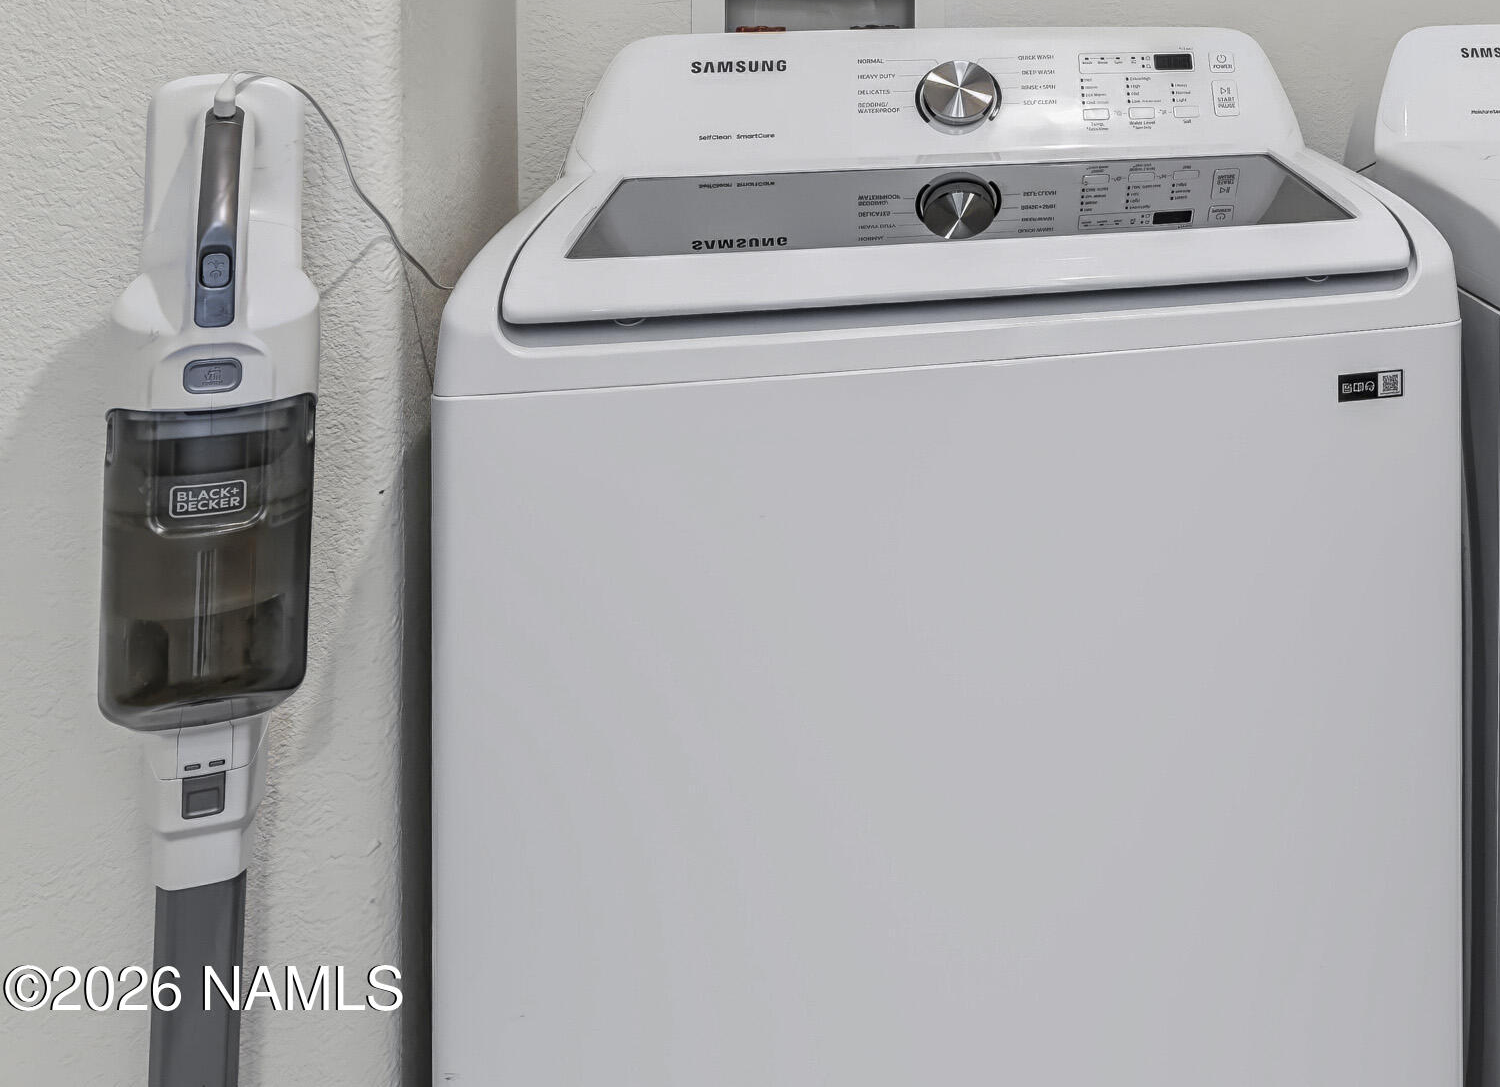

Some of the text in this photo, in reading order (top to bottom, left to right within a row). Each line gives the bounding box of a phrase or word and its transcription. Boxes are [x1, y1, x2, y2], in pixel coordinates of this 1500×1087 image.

[691, 59, 787, 74] SAMSUNG
[176, 487, 240, 503] BLACK+
[176, 497, 240, 512] DECKER
